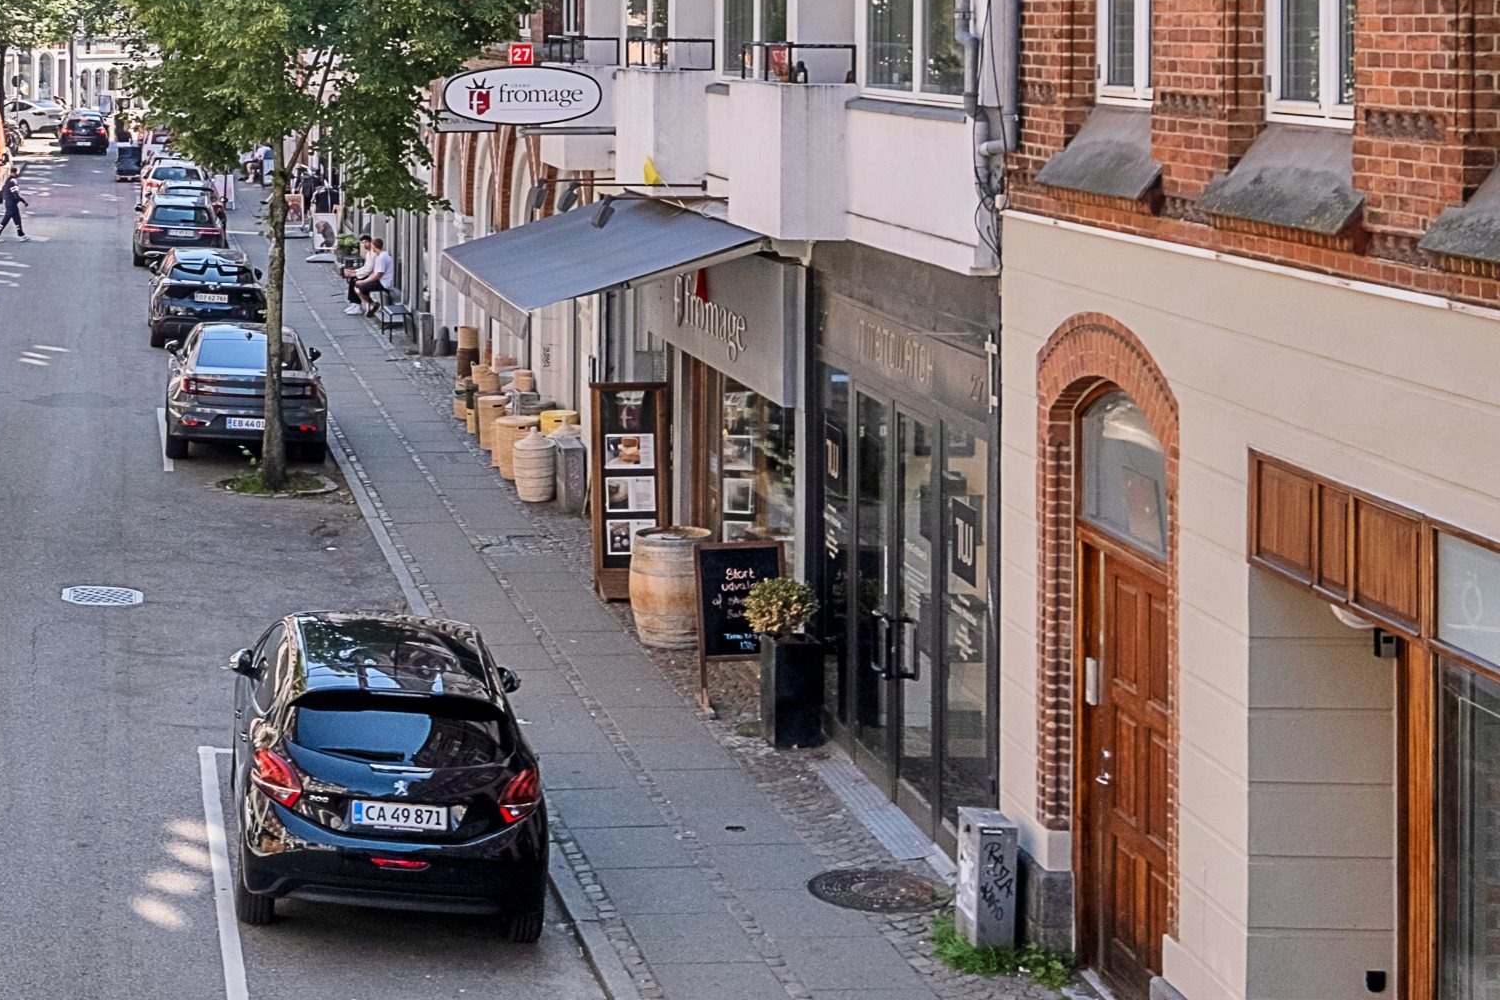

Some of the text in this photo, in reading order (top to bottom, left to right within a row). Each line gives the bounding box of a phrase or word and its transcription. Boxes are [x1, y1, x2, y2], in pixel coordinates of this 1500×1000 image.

[513, 48, 530, 61] 27
[499, 83, 583, 107] fromage
[685, 274, 747, 363] fromage
[245, 420, 255, 428] 44
[725, 567, 755, 580] Stort
[365, 805, 442, 826] CA 49 871
